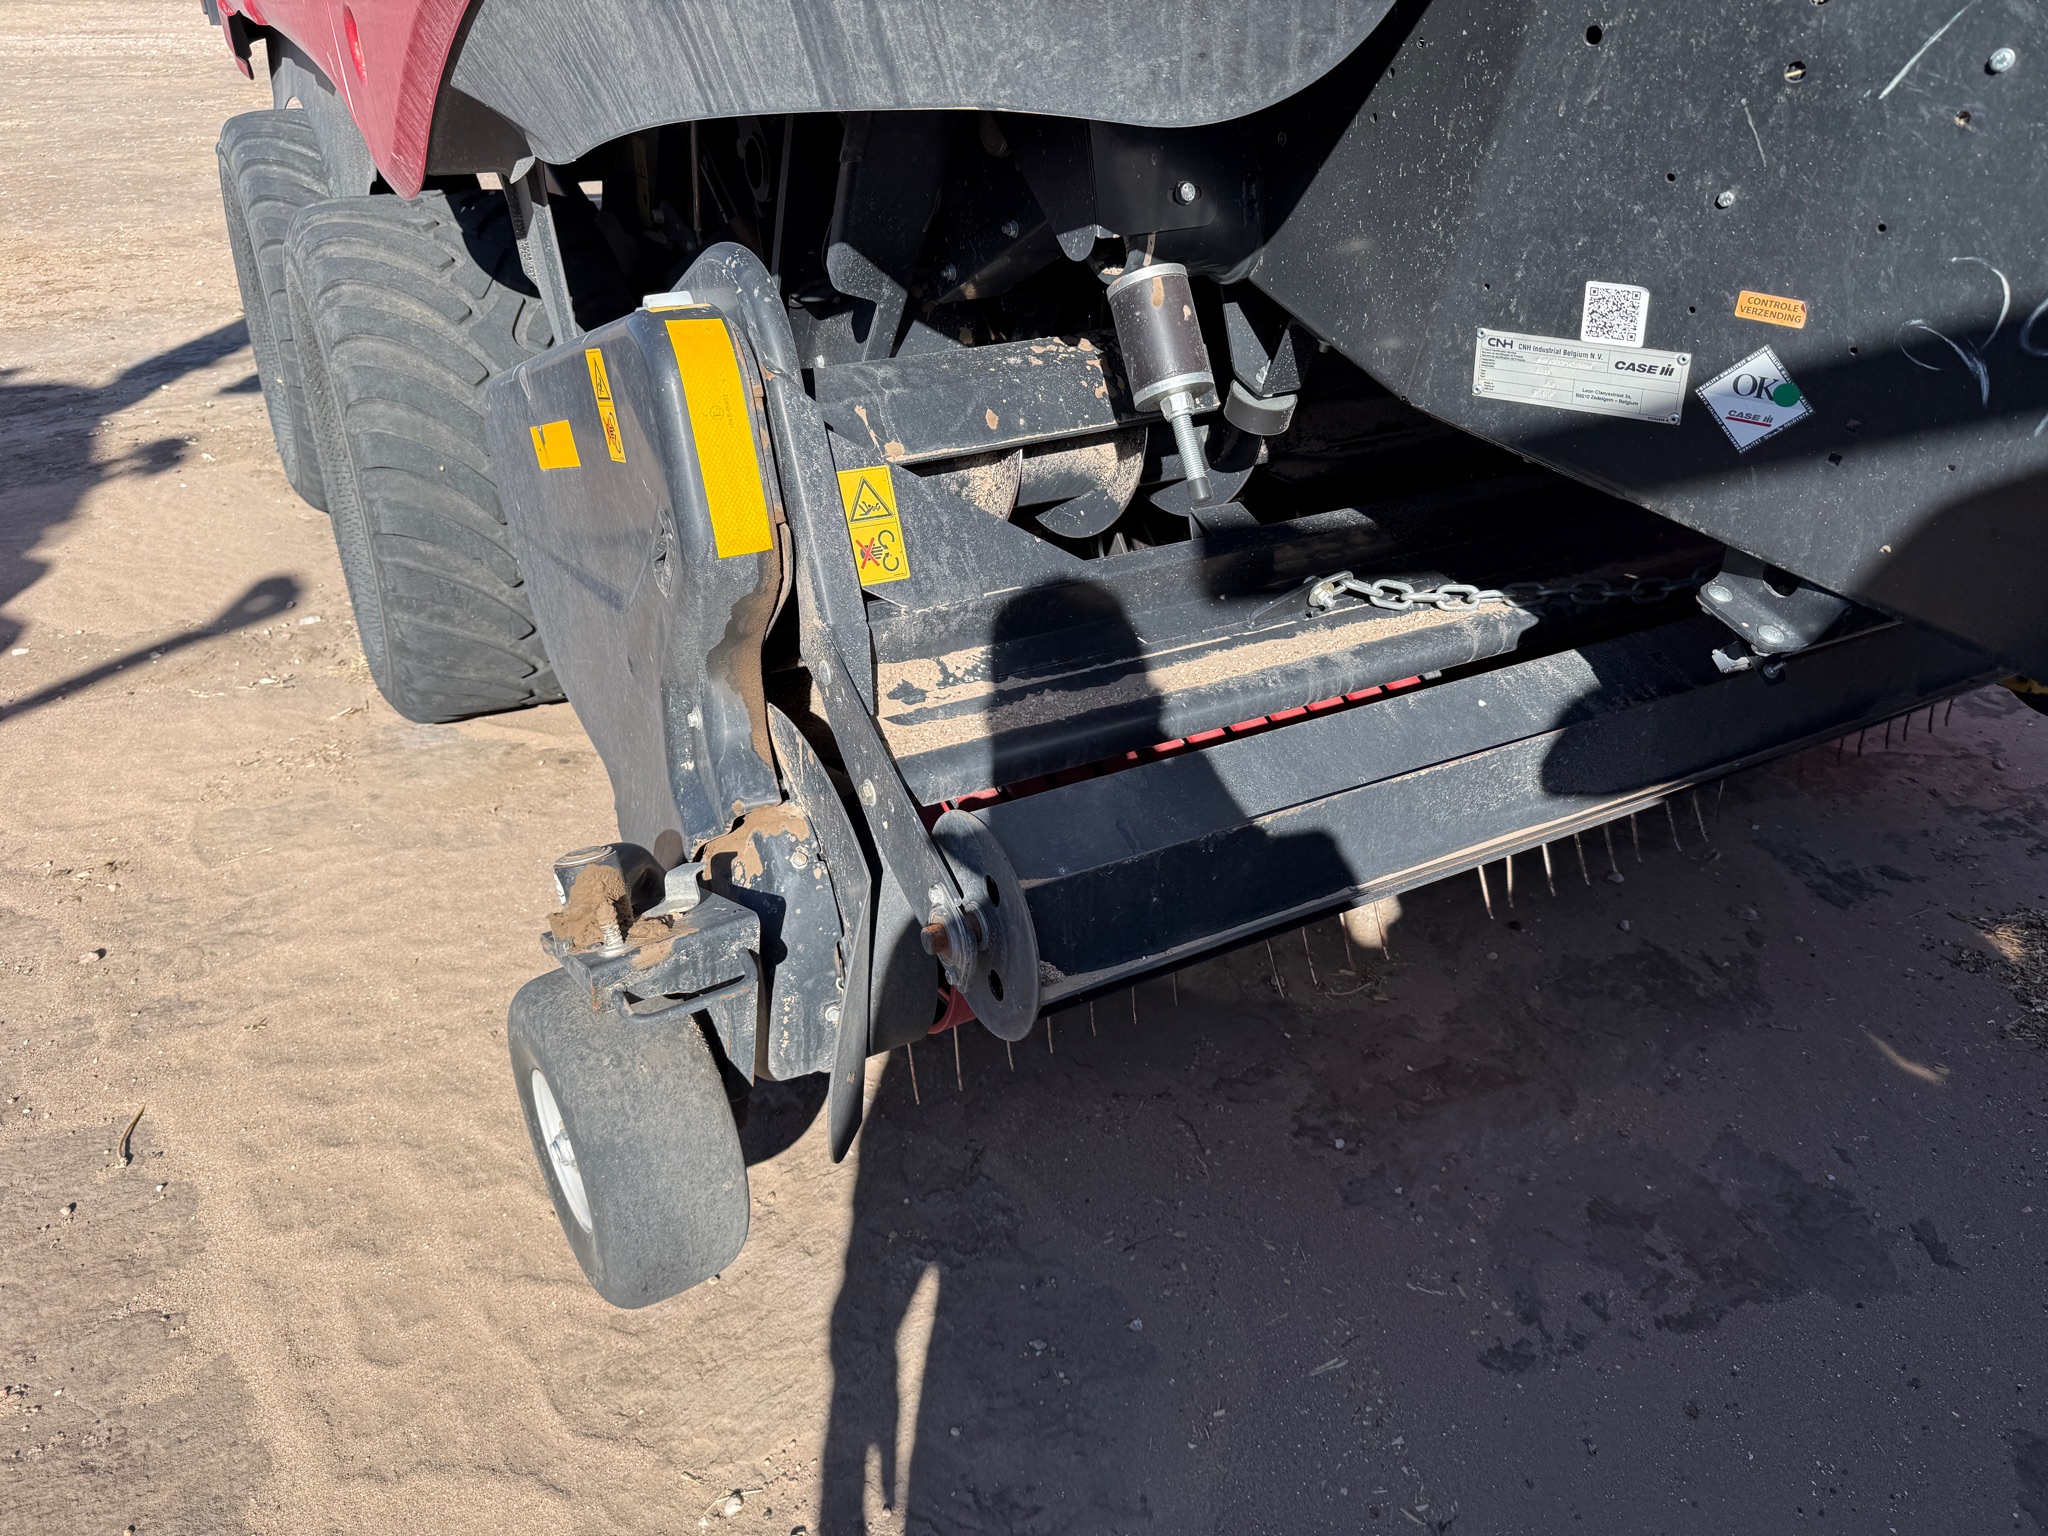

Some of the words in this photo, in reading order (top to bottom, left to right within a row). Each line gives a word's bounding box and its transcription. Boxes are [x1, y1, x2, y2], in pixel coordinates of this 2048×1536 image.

[1748, 296, 1800, 312] CONTROLE
[1740, 304, 1802, 324] VERZENDING
[1488, 338, 1514, 349] CNH
[1532, 345, 1562, 355] Industrial
[1563, 349, 1588, 358] Belgium
[1614, 361, 1658, 374] CASE
[1732, 374, 1780, 401] OK
[1728, 410, 1761, 421] CASE
